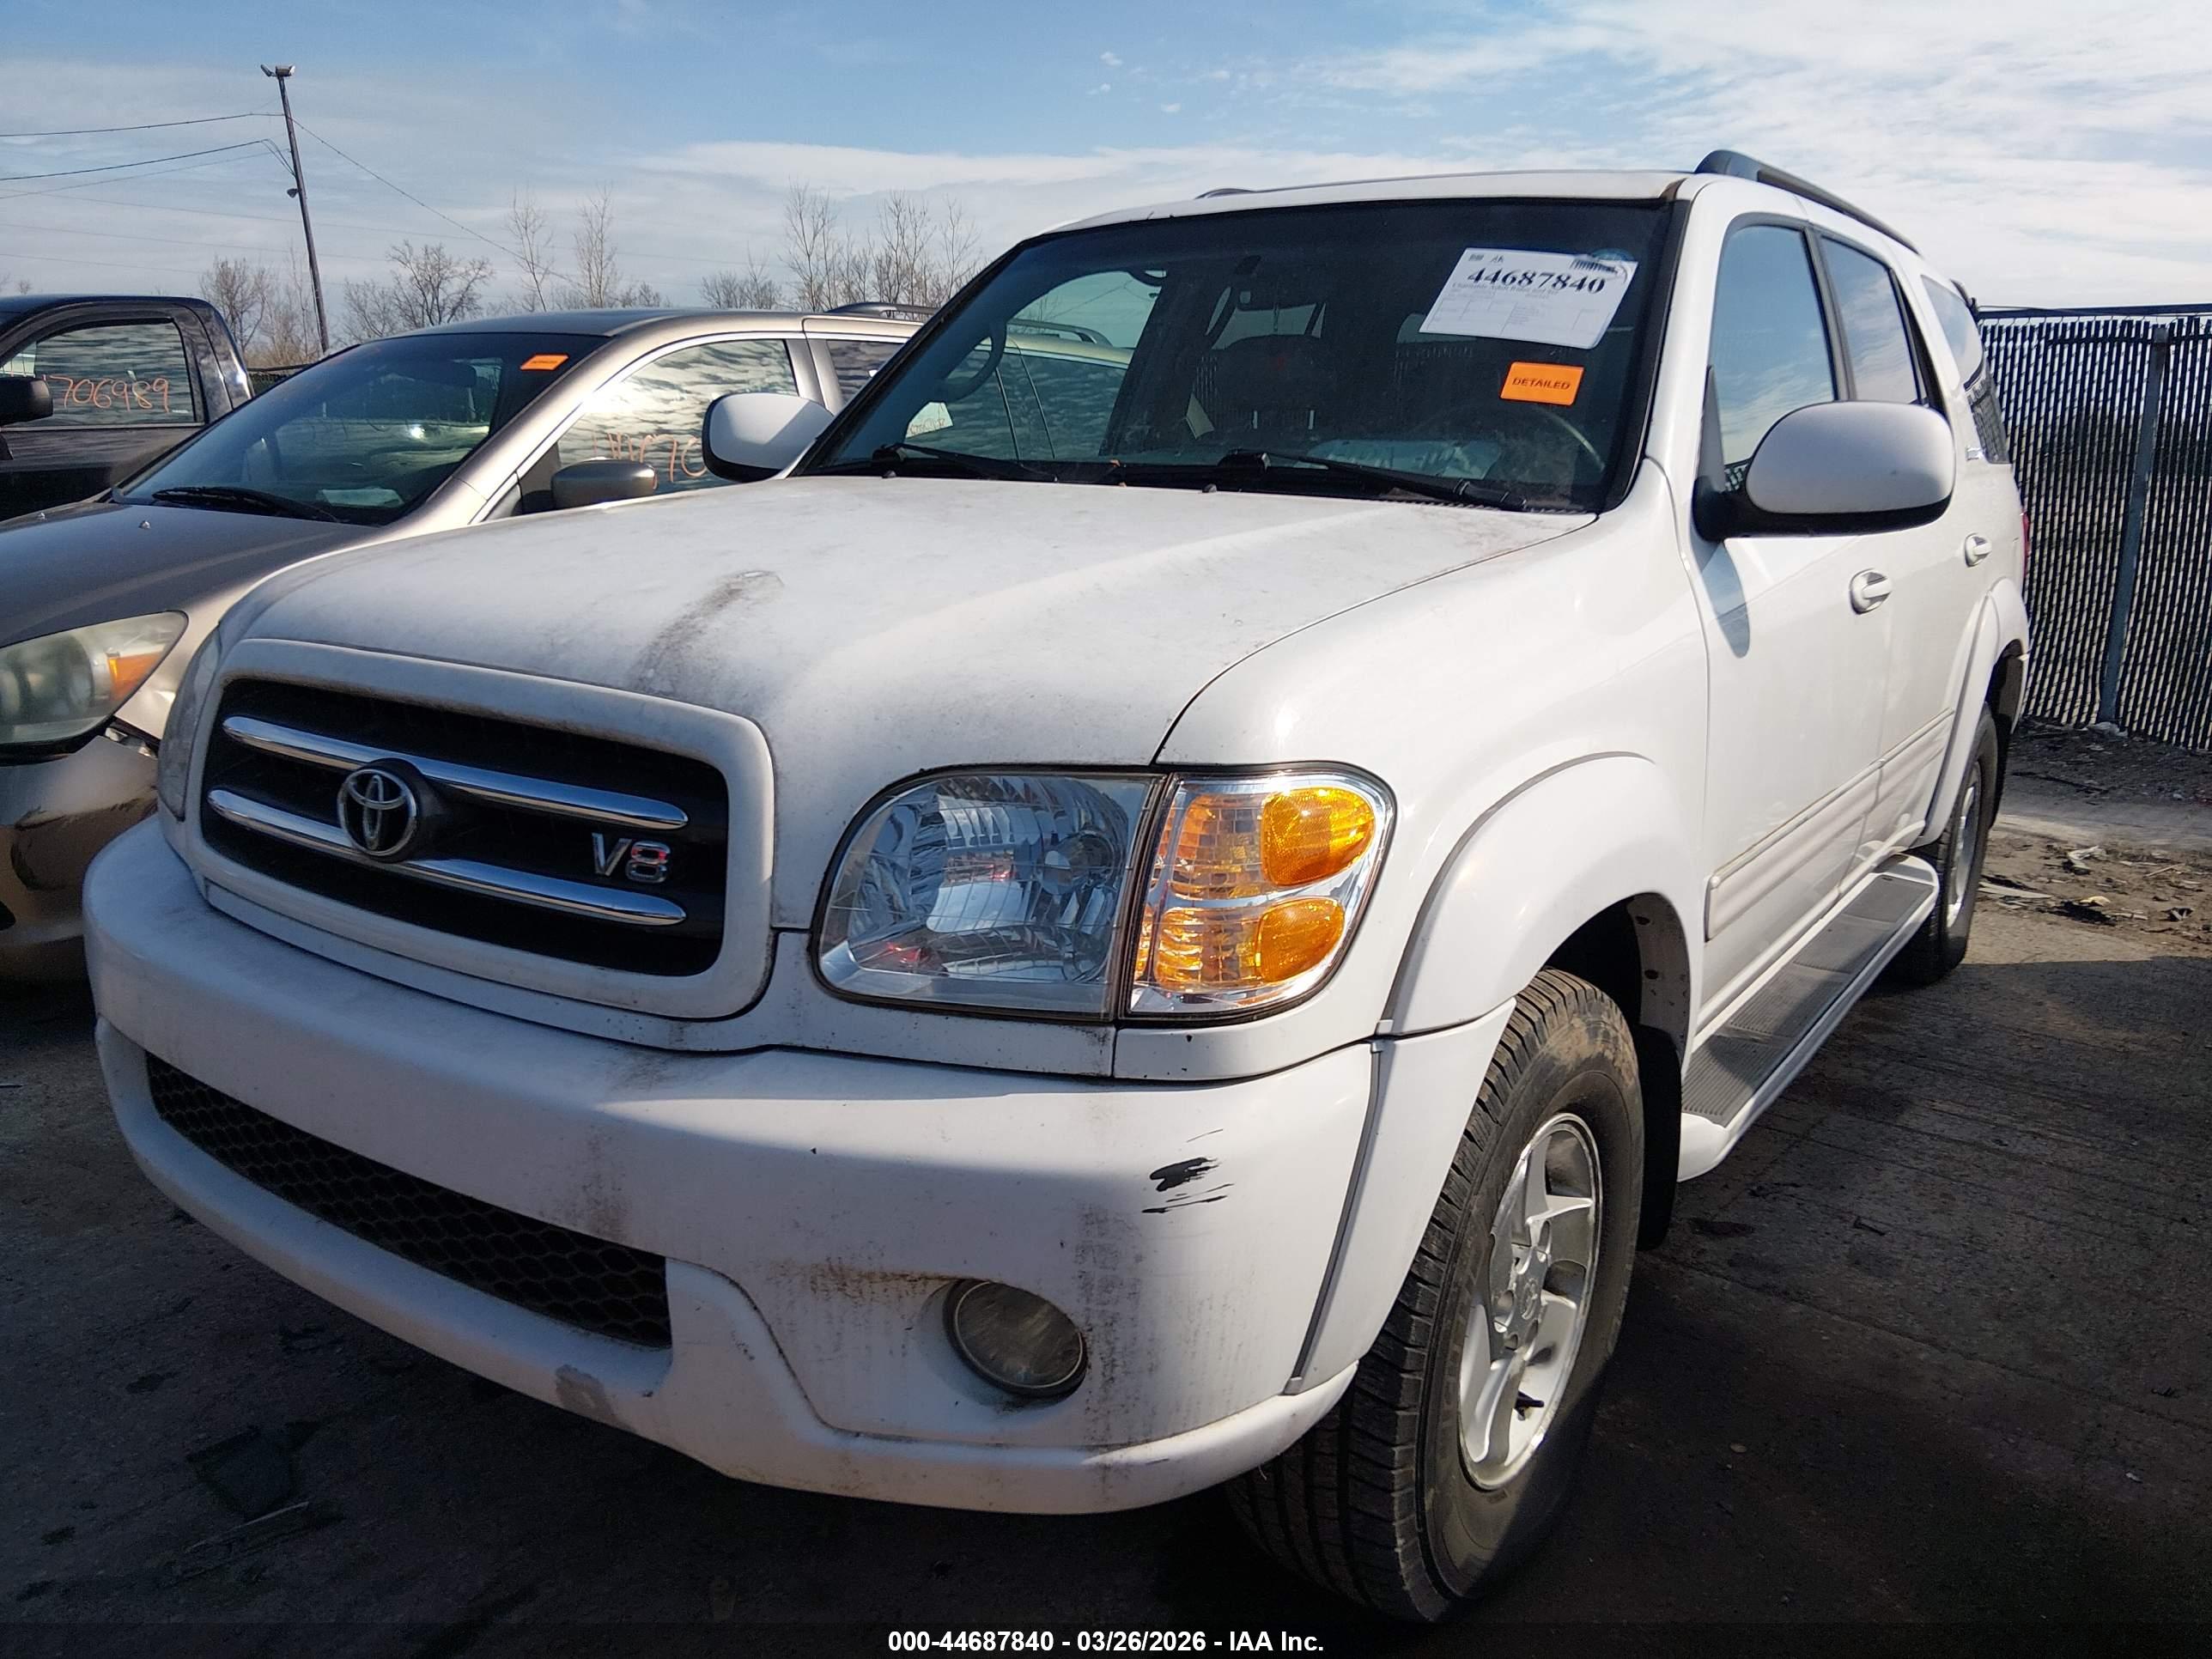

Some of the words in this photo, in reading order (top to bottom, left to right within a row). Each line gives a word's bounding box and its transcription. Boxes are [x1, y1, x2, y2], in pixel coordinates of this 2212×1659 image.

[1467, 268, 1606, 294] 44687840
[10, 370, 170, 412] 706989
[1511, 378, 1571, 390] DETAILED
[591, 832, 671, 884] V8
